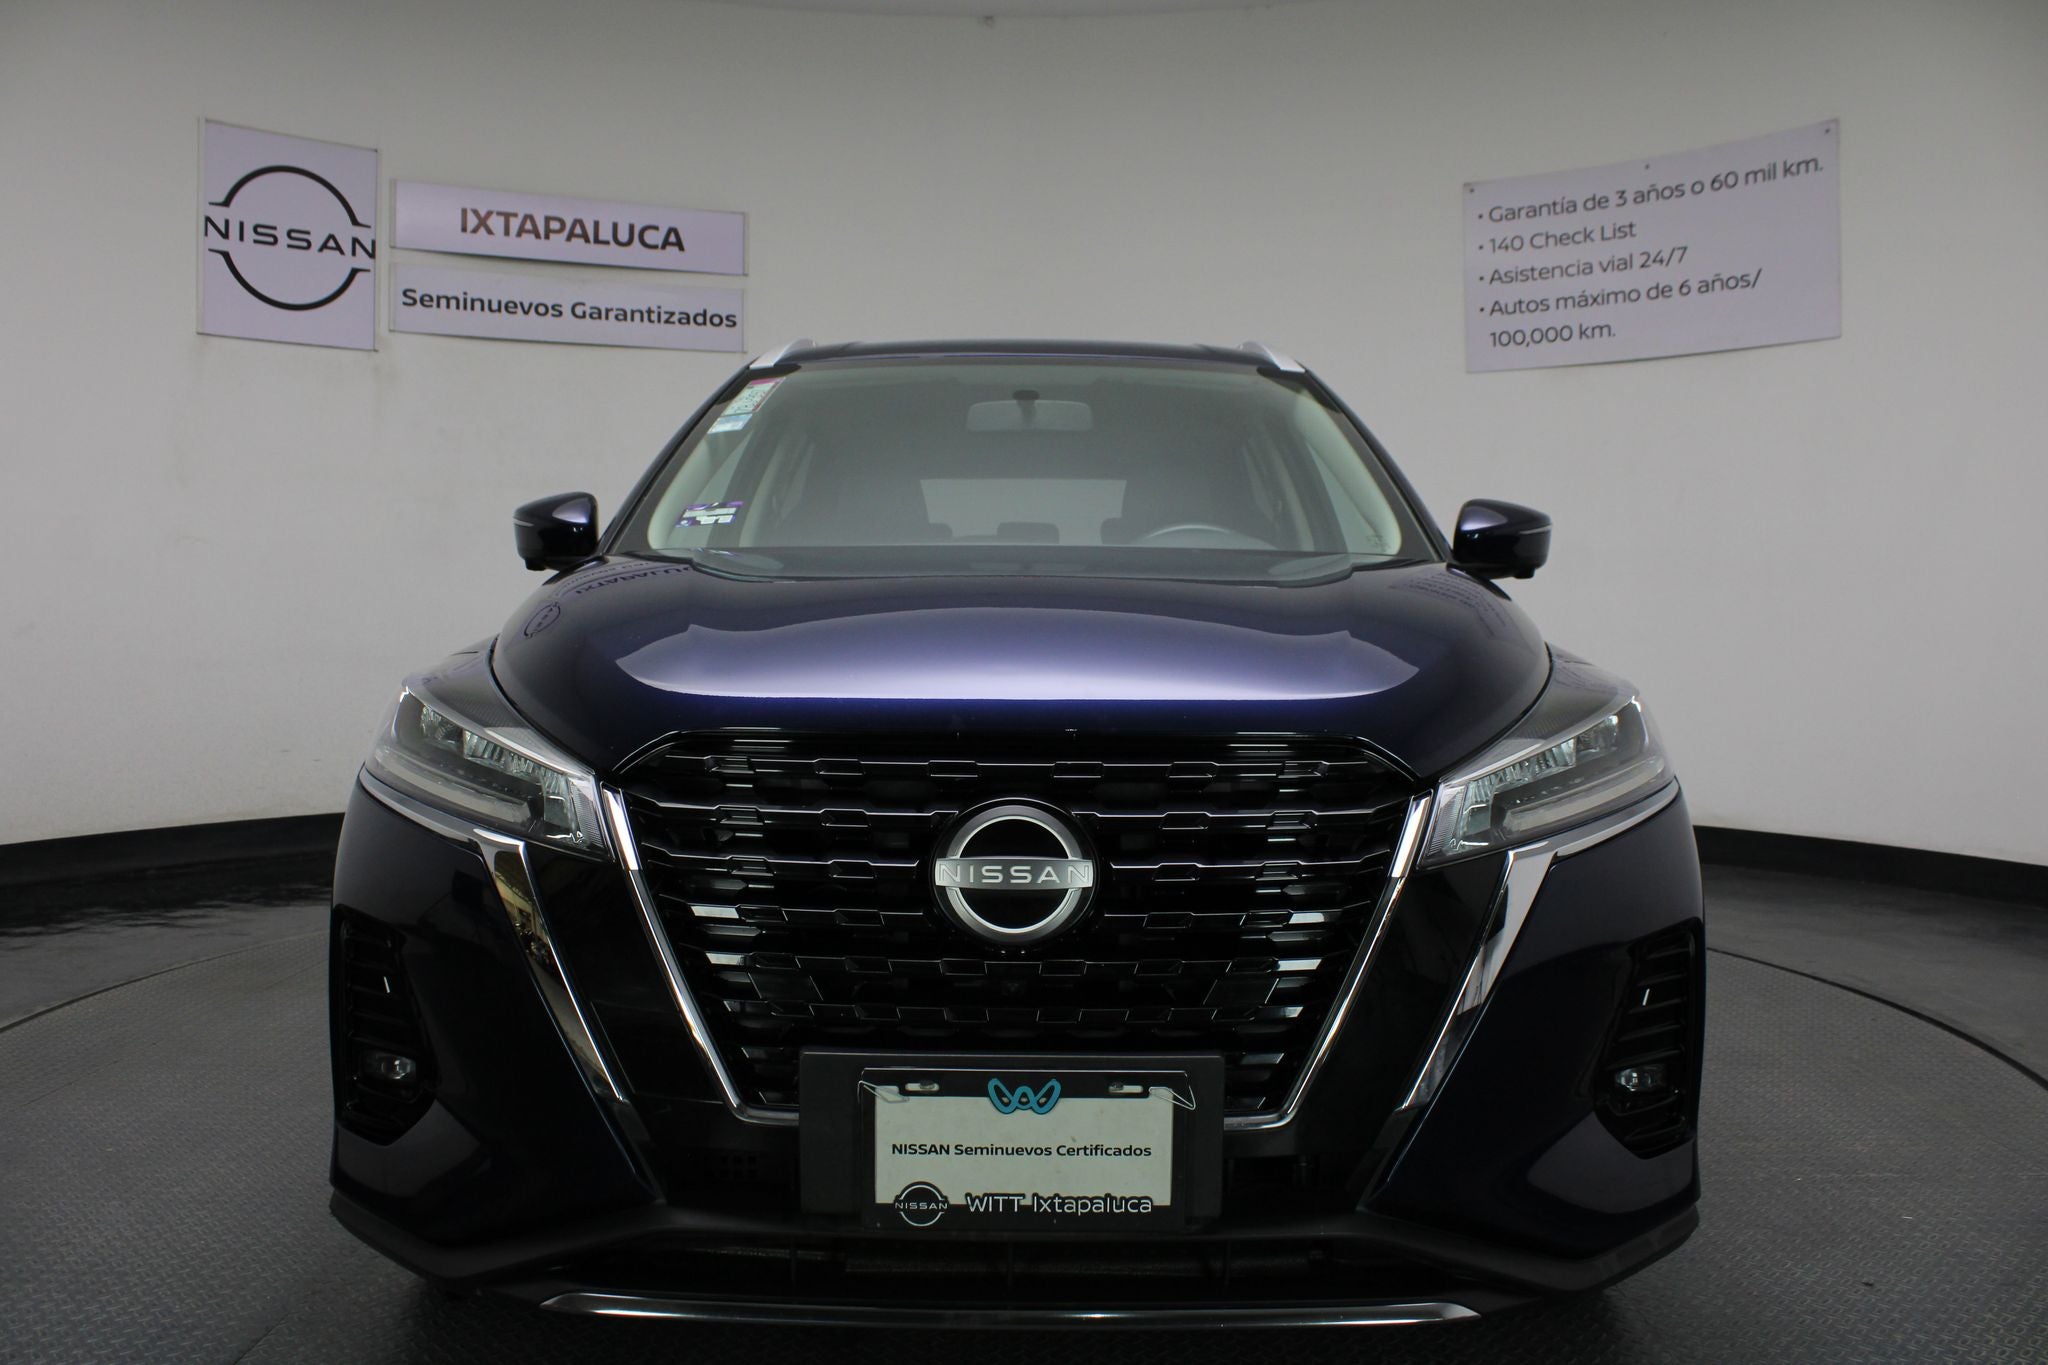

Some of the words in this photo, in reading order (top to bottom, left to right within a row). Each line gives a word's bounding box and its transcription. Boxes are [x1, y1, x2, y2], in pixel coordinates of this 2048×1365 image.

[1489, 196, 1576, 223] Garantía
[1583, 193, 1609, 212] de
[1616, 190, 1628, 208] 3
[1633, 183, 1685, 204] años
[1691, 180, 1704, 195] o
[1710, 172, 1738, 192] 60
[1745, 162, 1776, 185] mil
[1783, 156, 1823, 178] km.
[204, 216, 375, 259] NISSAN
[460, 207, 685, 251] IXTAPALUCA
[1489, 236, 1524, 254] 140
[1530, 227, 1594, 249] Check
[1601, 222, 1637, 241] List
[1489, 259, 1593, 285] Asistencia
[1598, 253, 1633, 273] vial
[1639, 246, 1688, 269] 24/7
[402, 288, 563, 318] Seminuevos
[570, 302, 737, 329] Garantizados
[1489, 296, 1550, 316] Autos
[1556, 286, 1640, 311] máximo
[1646, 281, 1673, 301] de
[1679, 278, 1691, 296] 6
[1697, 269, 1763, 294] años/
[1490, 326, 1573, 349] 100,000
[1579, 323, 1616, 340] km.
[939, 864, 1089, 883] NISSAN
[892, 1144, 950, 1156] NISSAN
[954, 1144, 1052, 1156] Seminuevos
[1056, 1144, 1151, 1157] Certificados
[895, 1202, 948, 1210] NISSAN
[966, 1196, 1024, 1212] WITT
[1034, 1195, 1152, 1215] Ixtapaluca
